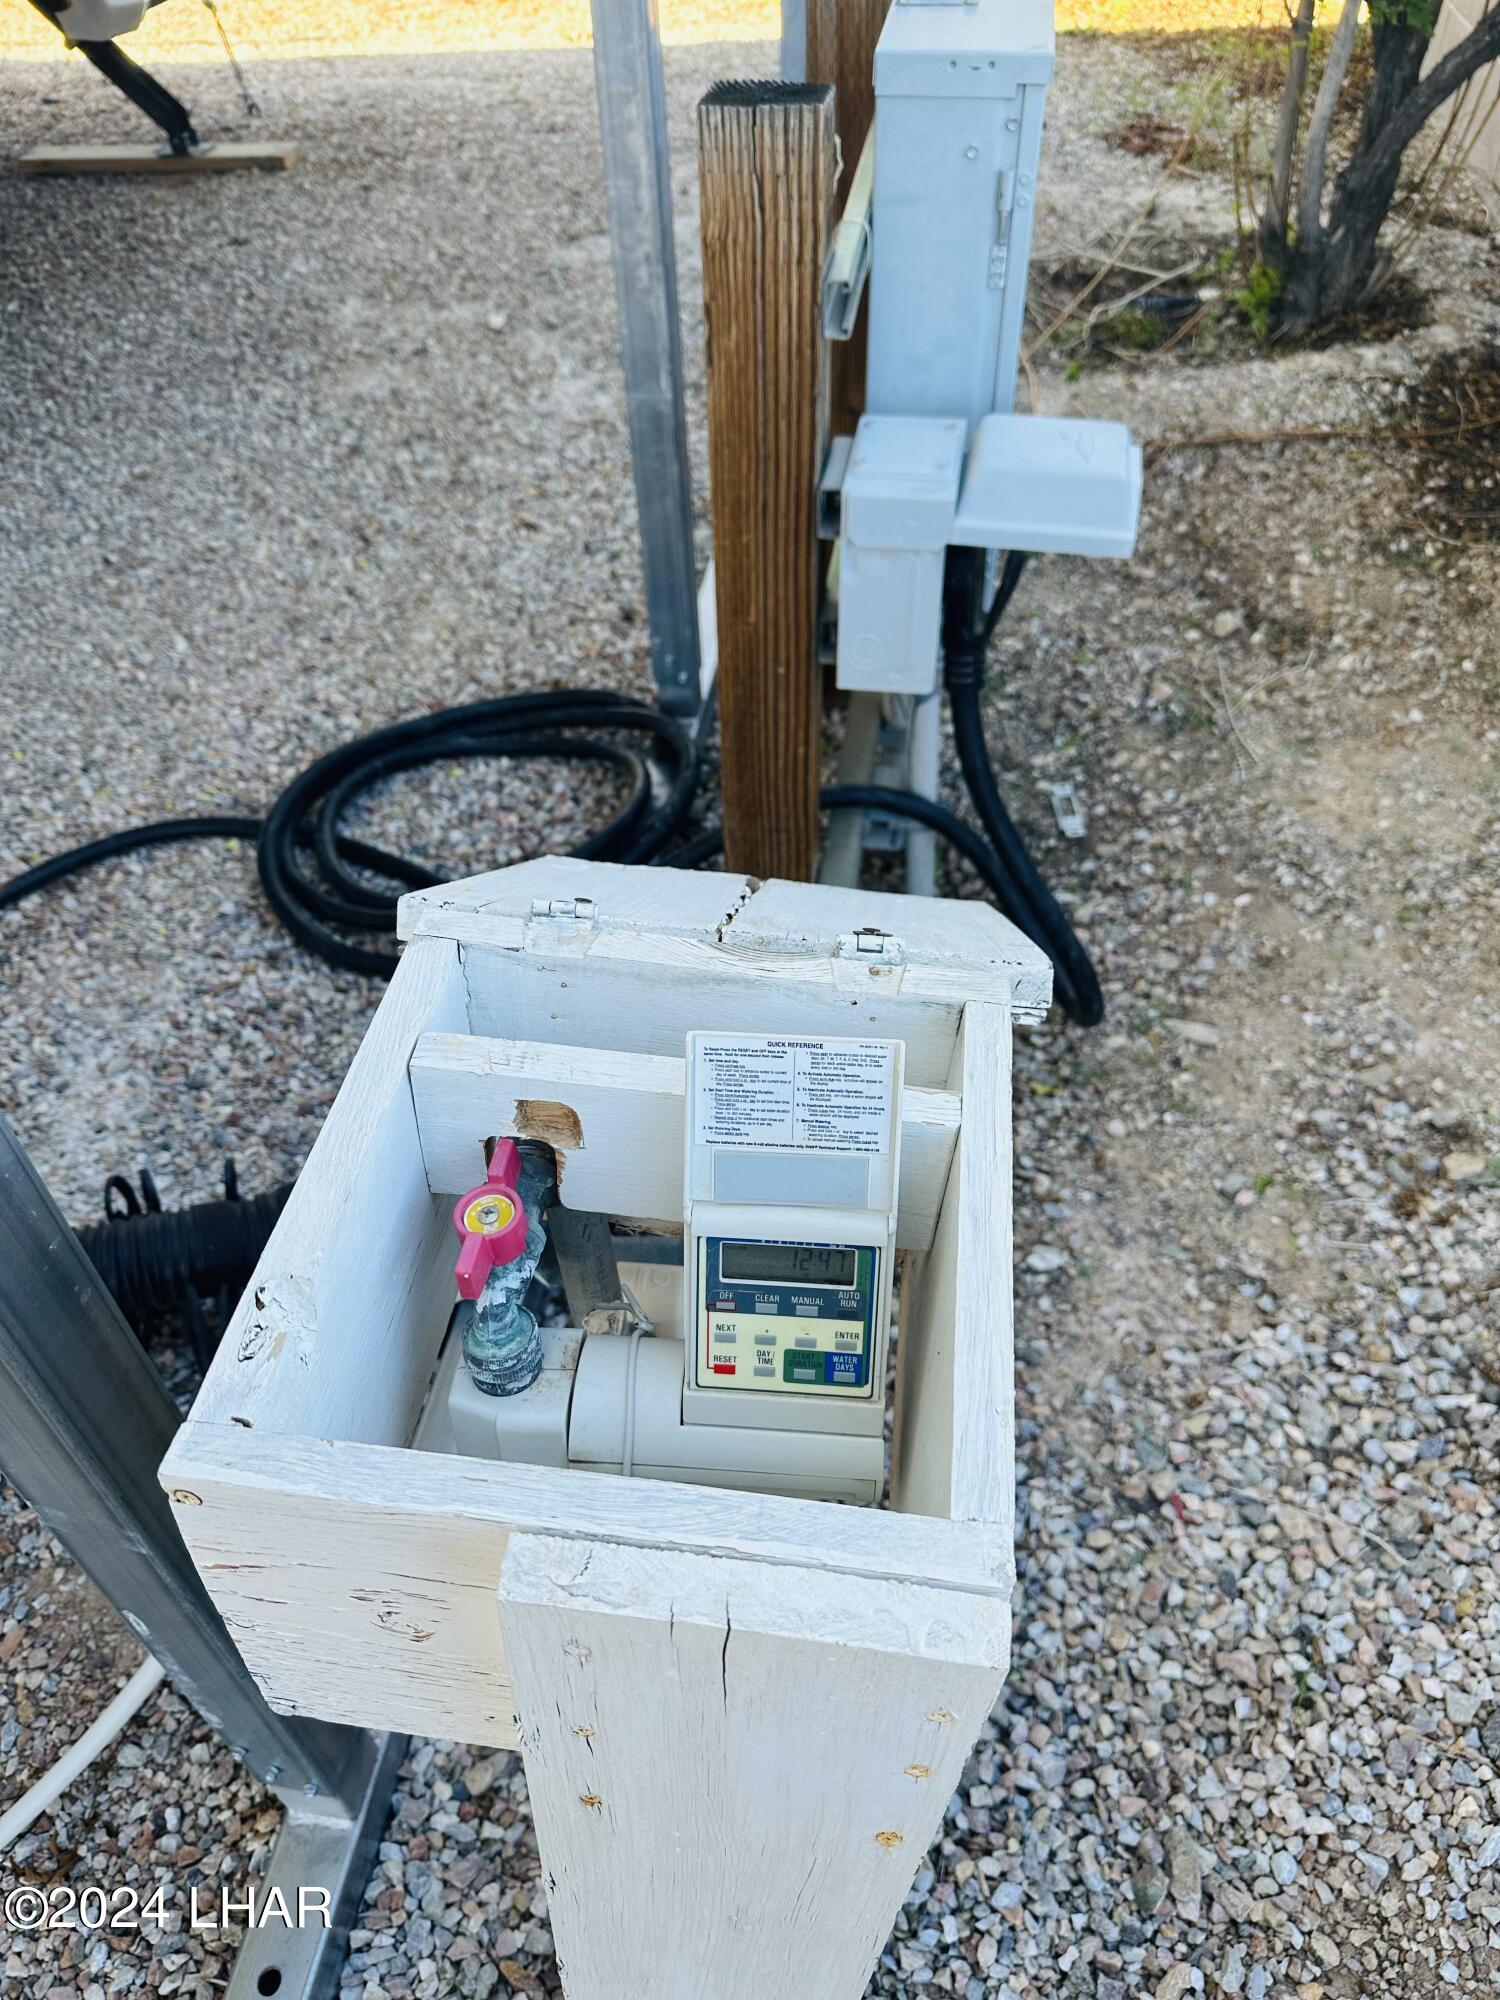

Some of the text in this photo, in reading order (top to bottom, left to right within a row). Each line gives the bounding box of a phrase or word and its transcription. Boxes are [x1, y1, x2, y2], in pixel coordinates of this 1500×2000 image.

[788, 1042, 823, 1050] REFERENCE
[793, 1248, 846, 1272] 12:47
[720, 1292, 734, 1300] OFF
[756, 1294, 780, 1303] CLEAR
[839, 1291, 860, 1300] AUTO
[792, 1296, 824, 1306] MANUAL
[840, 1300, 857, 1308] RUN
[716, 1324, 736, 1332] NEXT
[835, 1332, 860, 1340] ENTER
[714, 1355, 736, 1363] RESET
[758, 1357, 774, 1366] TIME
[787, 1359, 824, 1368] DURATION
[832, 1355, 858, 1364] WATER
[835, 1363, 854, 1372] DAYS
